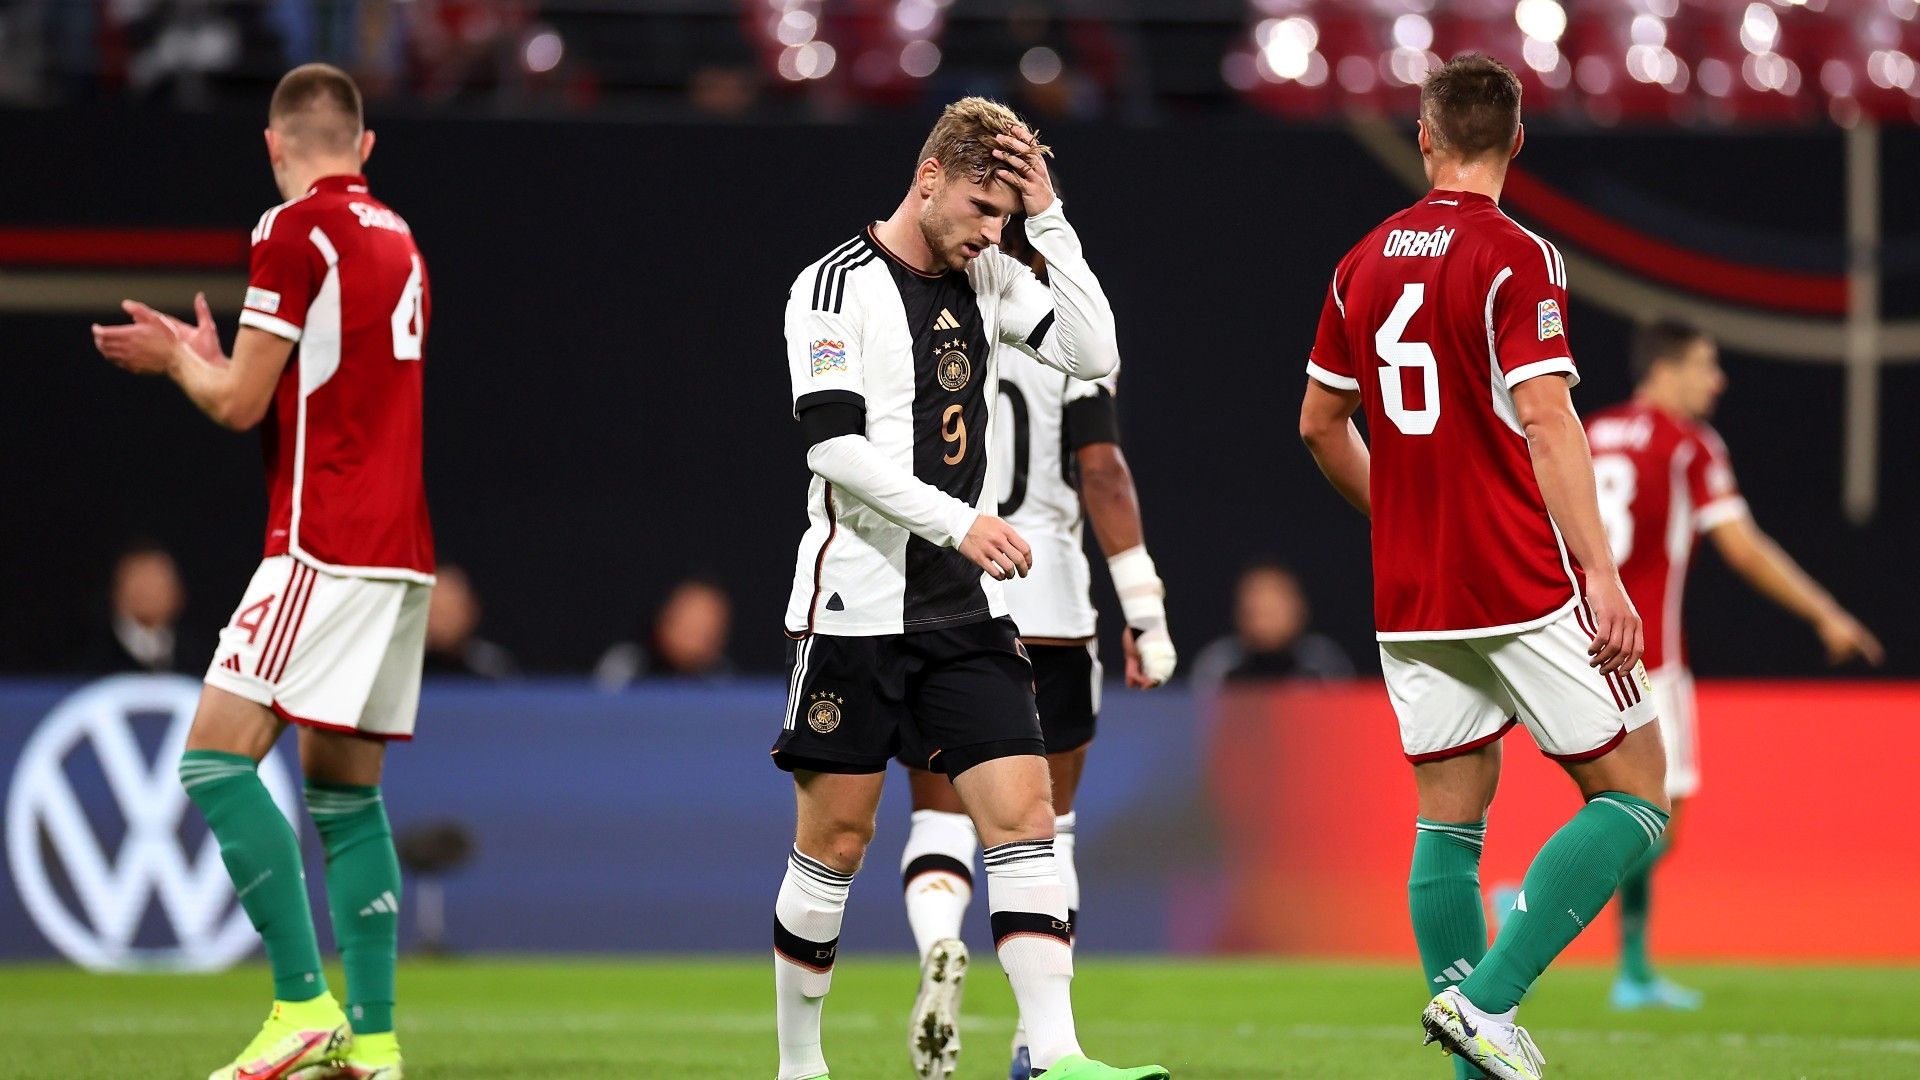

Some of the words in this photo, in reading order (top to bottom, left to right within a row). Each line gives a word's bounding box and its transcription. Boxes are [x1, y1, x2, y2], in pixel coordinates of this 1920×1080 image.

[1383, 225, 1456, 257] ORBÁN
[1375, 283, 1440, 435] 6
[942, 404, 967, 465] 9
[236, 594, 276, 645] 4
